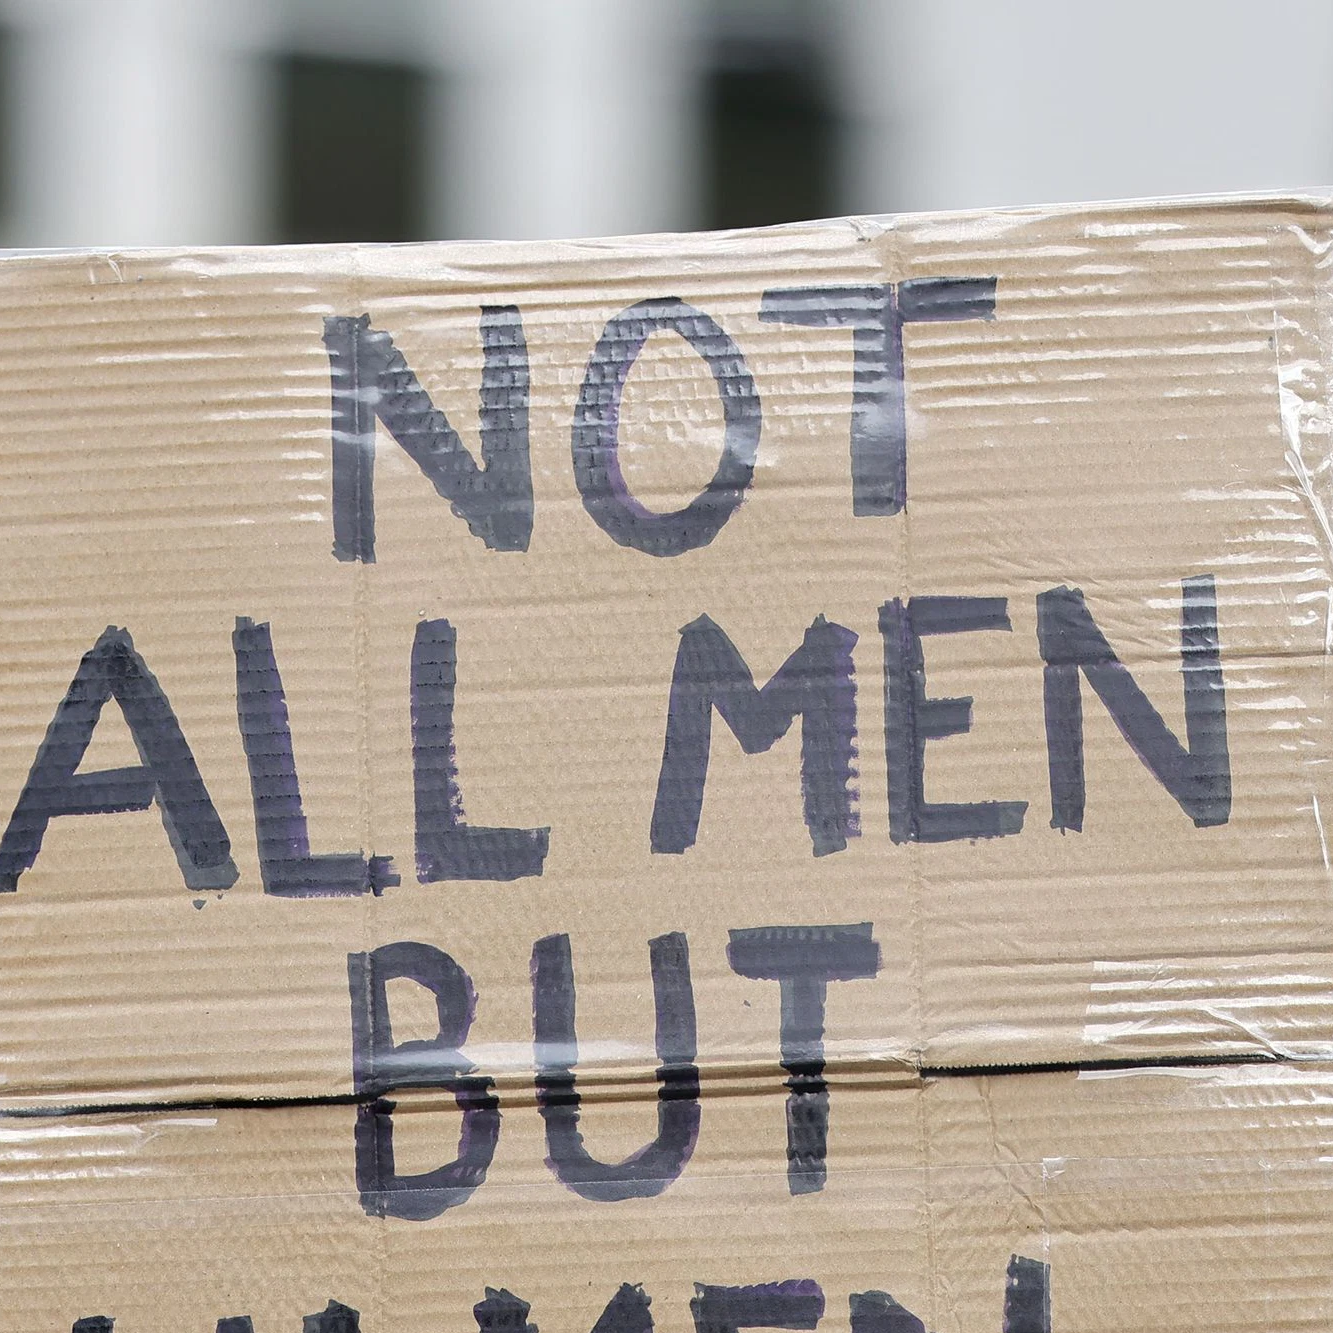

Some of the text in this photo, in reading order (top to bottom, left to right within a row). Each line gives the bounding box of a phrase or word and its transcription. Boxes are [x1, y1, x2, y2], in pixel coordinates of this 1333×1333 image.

[326, 278, 997, 563] NOT
[650, 573, 1232, 857] MEN
[348, 923, 880, 1219] BUT
